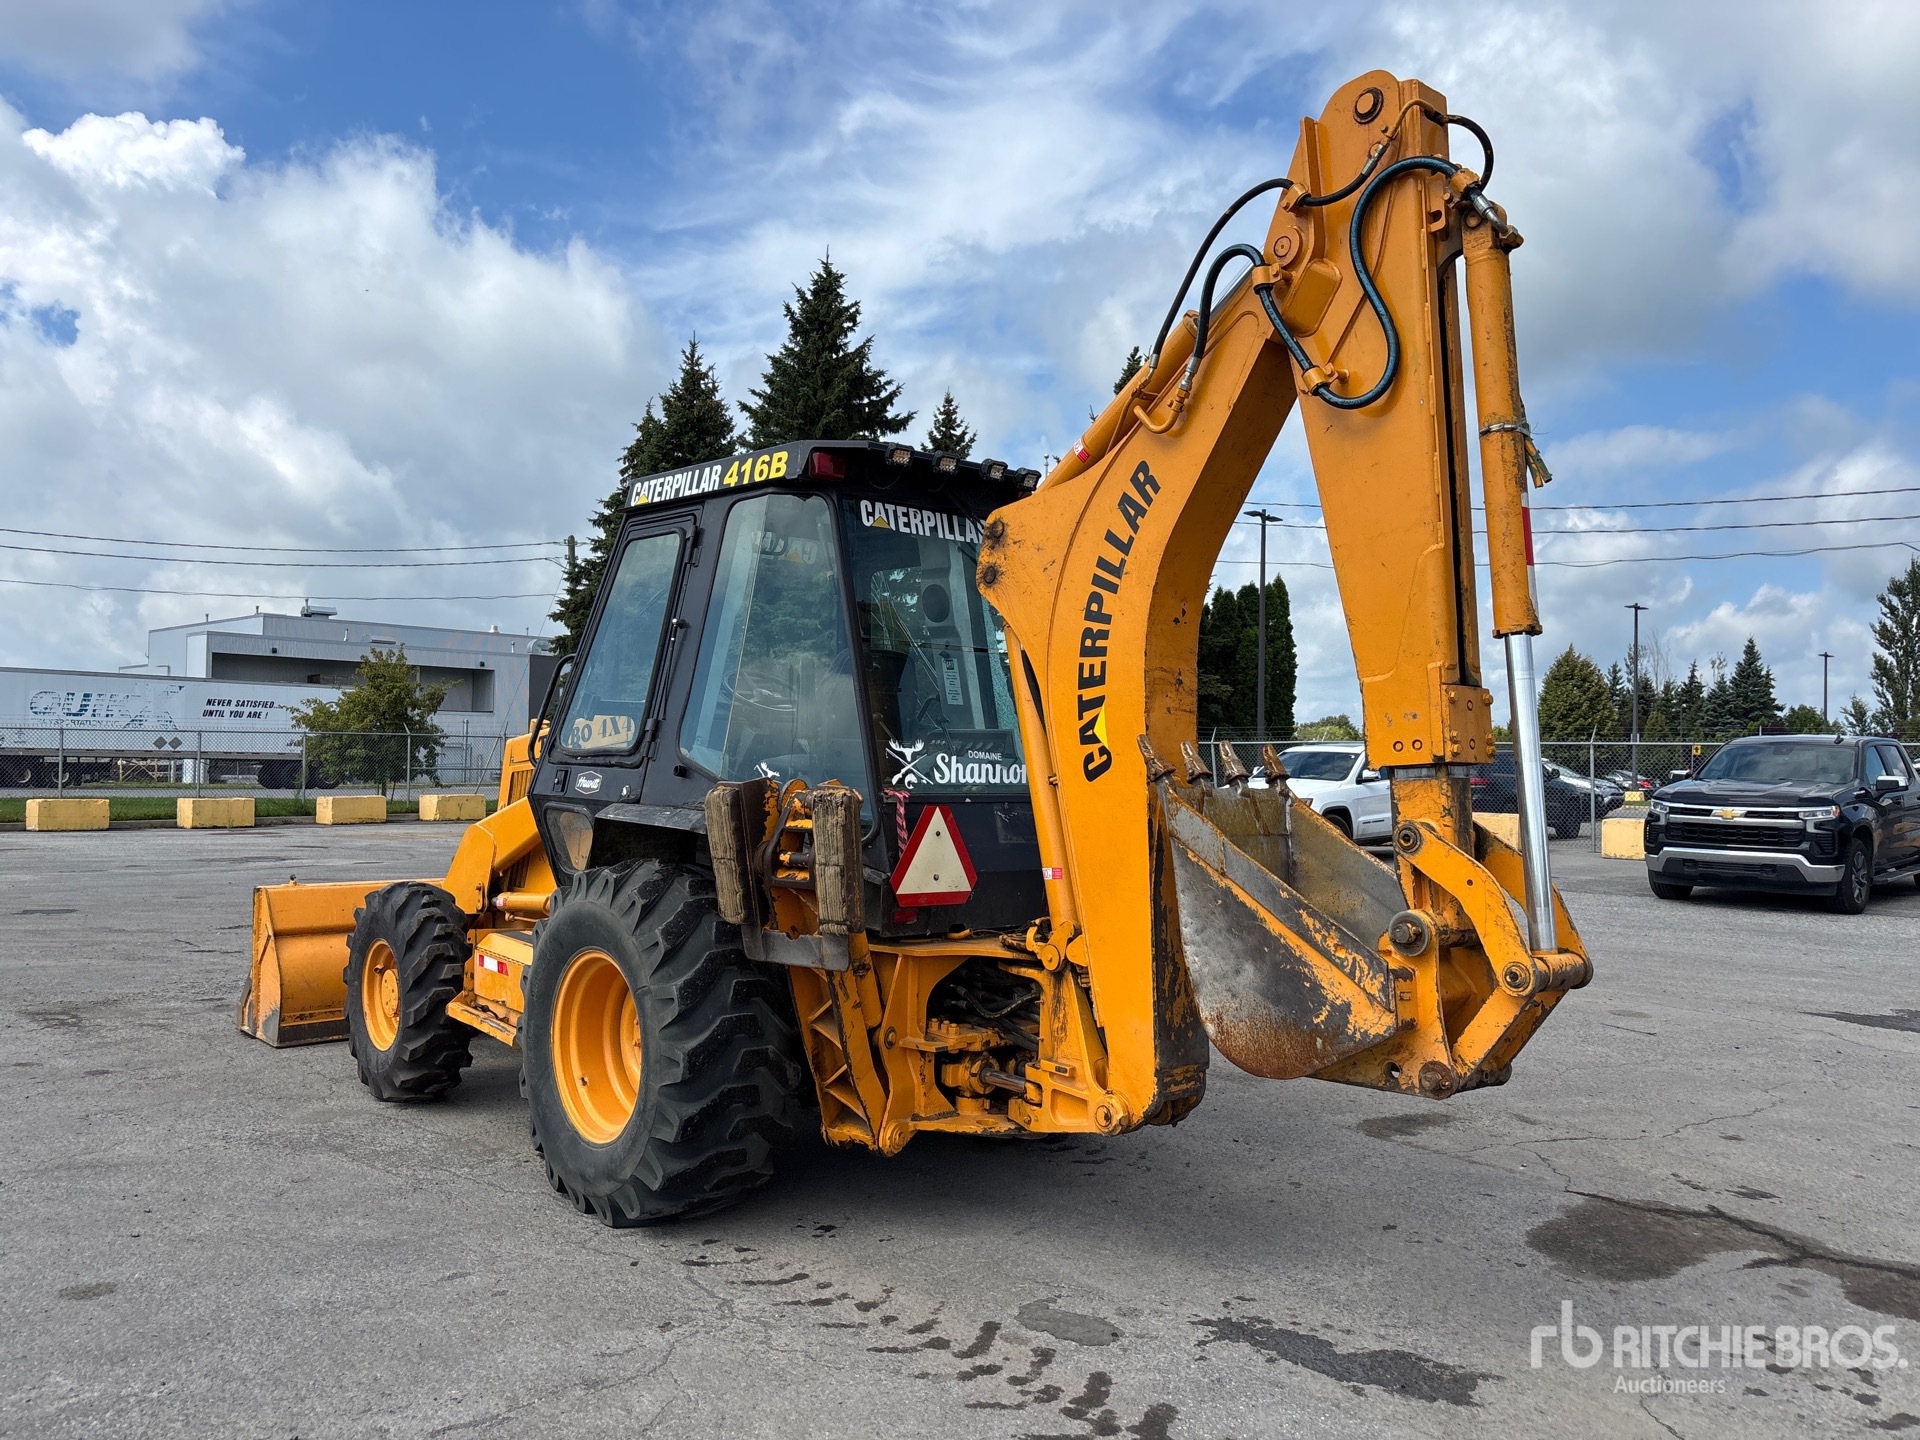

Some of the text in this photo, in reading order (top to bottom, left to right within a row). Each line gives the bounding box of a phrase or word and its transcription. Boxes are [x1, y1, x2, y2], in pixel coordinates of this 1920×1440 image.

[631, 450, 789, 507] CATERPILLAR 416B
[1076, 459, 1162, 783] CATERPILLAR
[205, 698, 232, 707] NEVER
[202, 709, 225, 718] UNTIL
[229, 710, 245, 719] YOU
[246, 711, 263, 719] ARE
[967, 750, 1003, 761] DOMAINE
